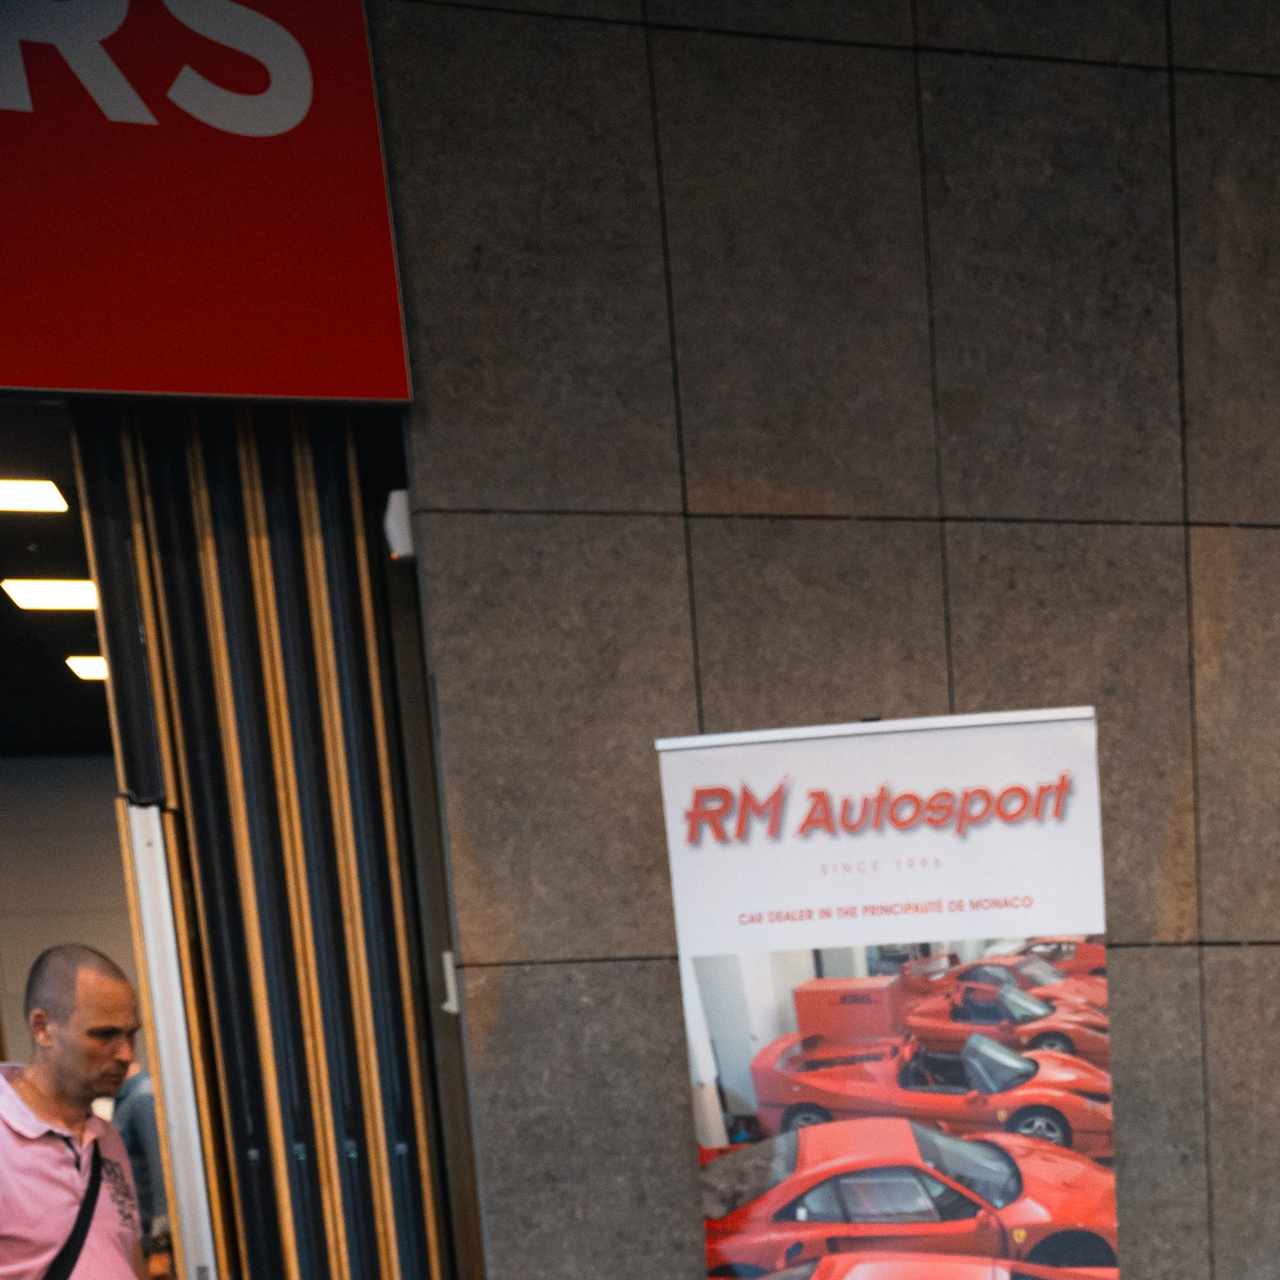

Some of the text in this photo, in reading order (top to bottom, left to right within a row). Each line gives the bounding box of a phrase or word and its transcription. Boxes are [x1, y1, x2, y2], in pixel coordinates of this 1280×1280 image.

[684, 770, 1071, 846] RM Autosport
[738, 912, 763, 925] CAR
[768, 909, 814, 923] DEALER
[818, 908, 833, 920] IN
[836, 906, 857, 919] THE
[947, 899, 964, 913] DE
[969, 895, 1034, 911] MONACO
